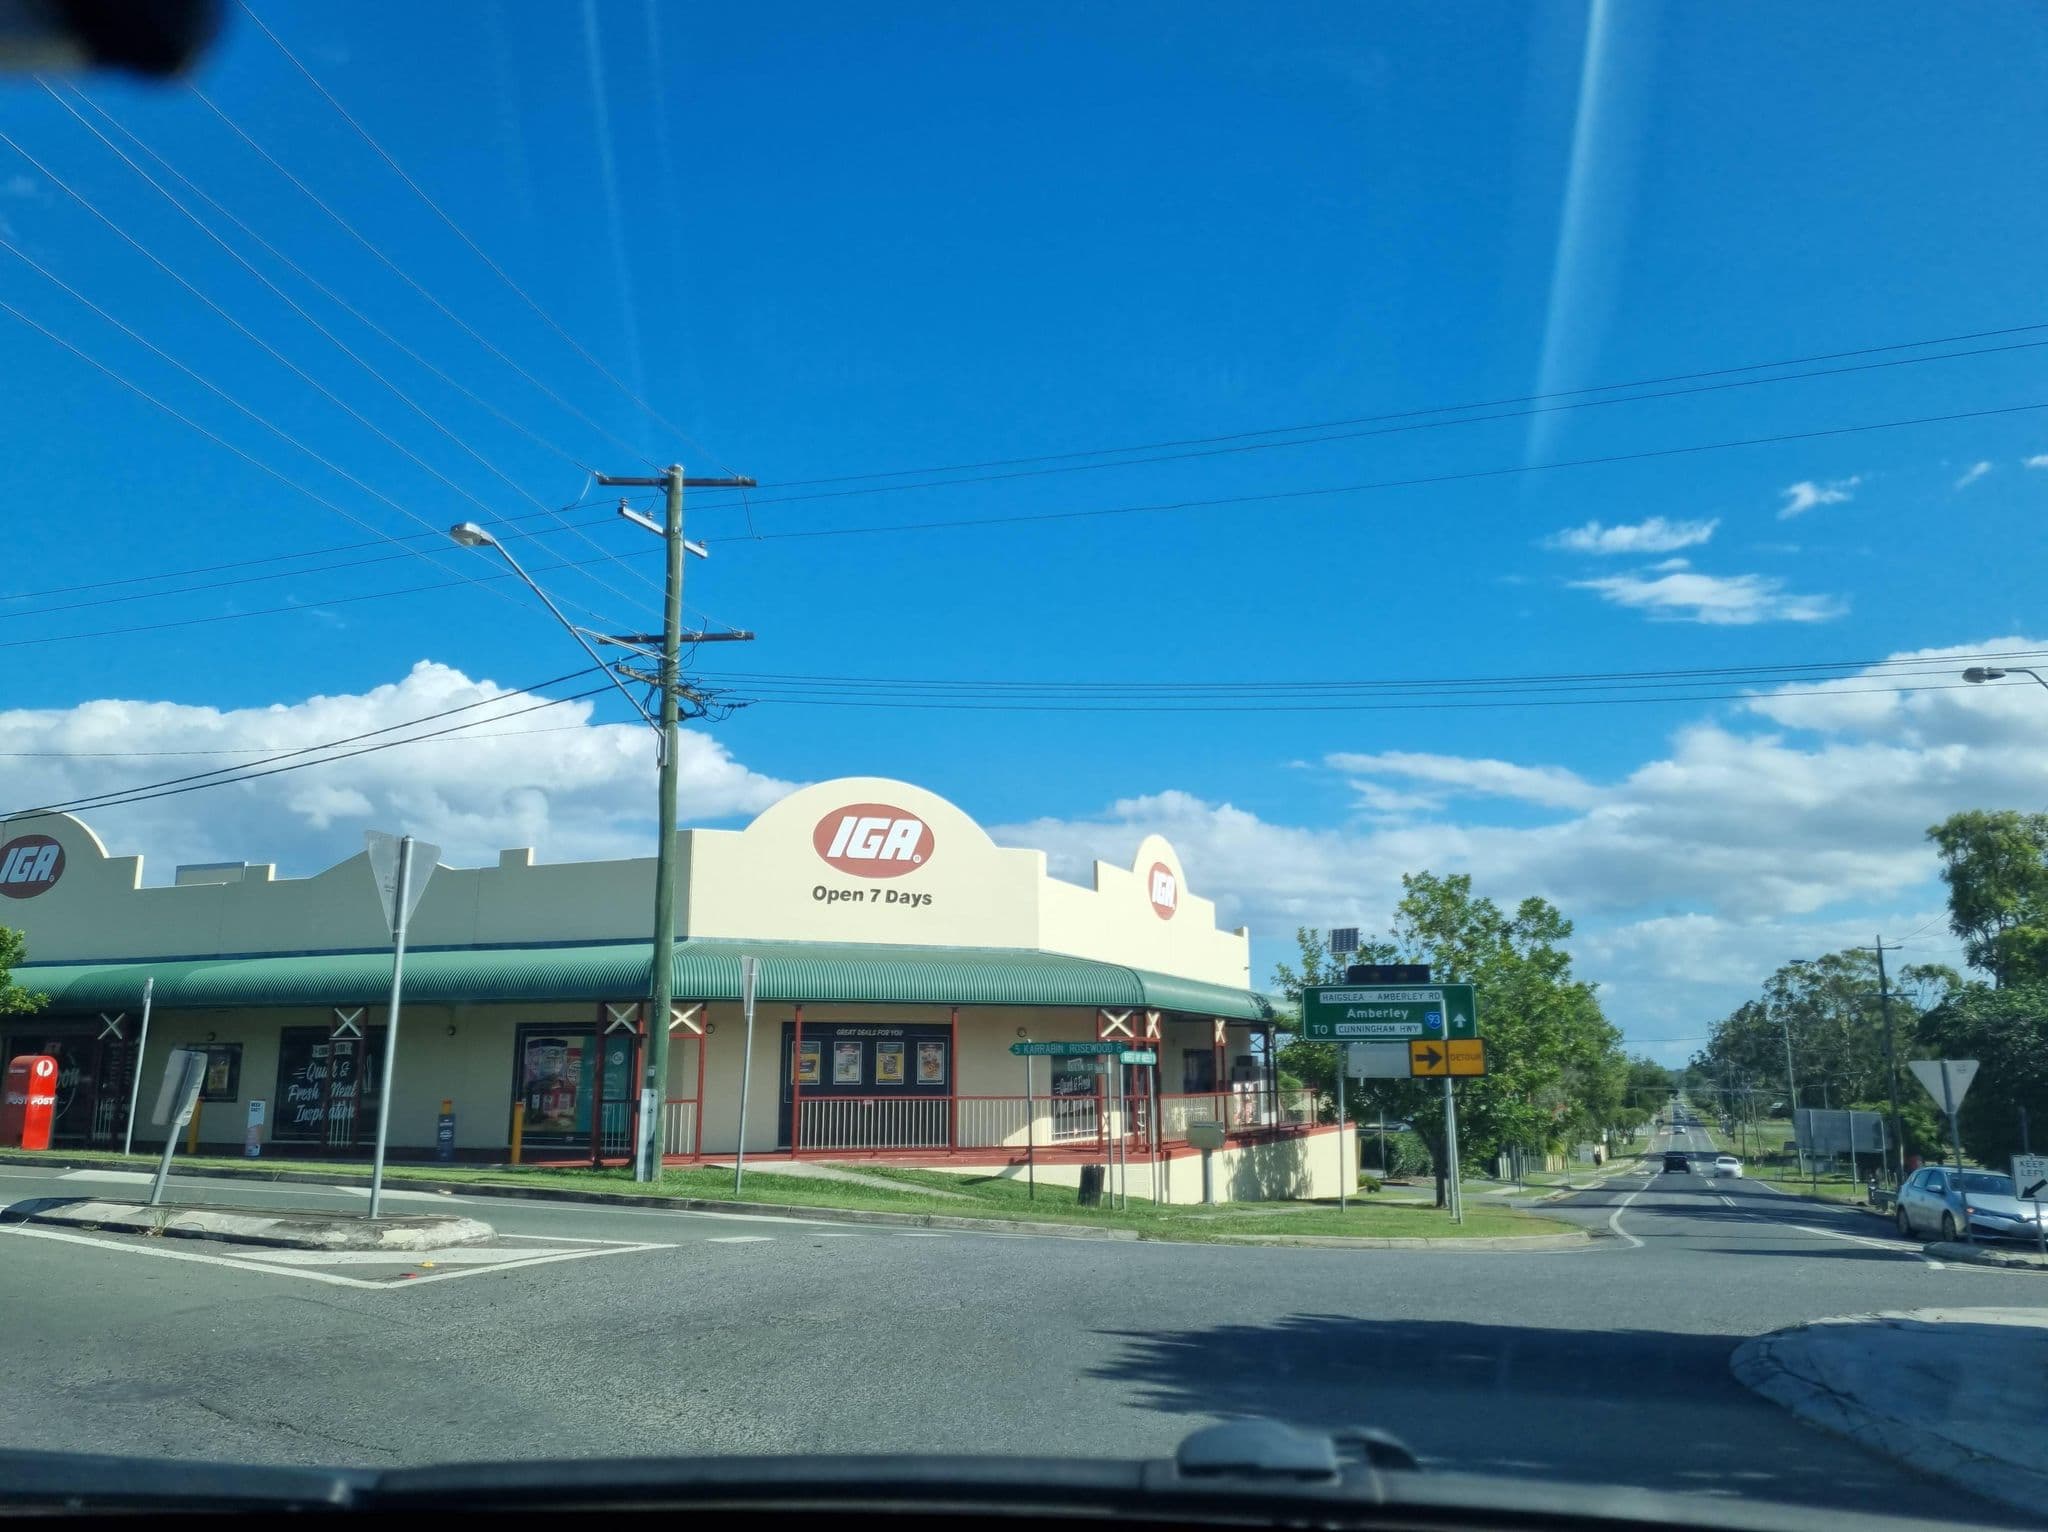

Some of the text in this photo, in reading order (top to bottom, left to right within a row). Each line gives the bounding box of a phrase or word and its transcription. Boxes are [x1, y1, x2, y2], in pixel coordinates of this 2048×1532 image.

[826, 816, 923, 861] IGA
[0, 845, 60, 884] IGA
[812, 885, 933, 908] Open 7 Days
[1322, 993, 1364, 1001] HAIGSLEA
[1377, 992, 1423, 1001] AMBERLEY
[1428, 992, 1441, 1000] RD
[1346, 1008, 1409, 1020] Amberley
[1427, 1014, 1441, 1025] 93
[1312, 1024, 1418, 1035] TO CUNNINGHAM HWY
[1023, 1044, 1064, 1054] KARRABIN
[1069, 1043, 1113, 1053] ROSEWOOD
[306, 1060, 338, 1082] Quik
[288, 1080, 358, 1103] Fresh Meal
[31, 1095, 56, 1105] POST
[295, 1101, 355, 1126] Inspiation
[2020, 1160, 2046, 1169] KEEP
[2020, 1169, 2045, 1177] LEFT
